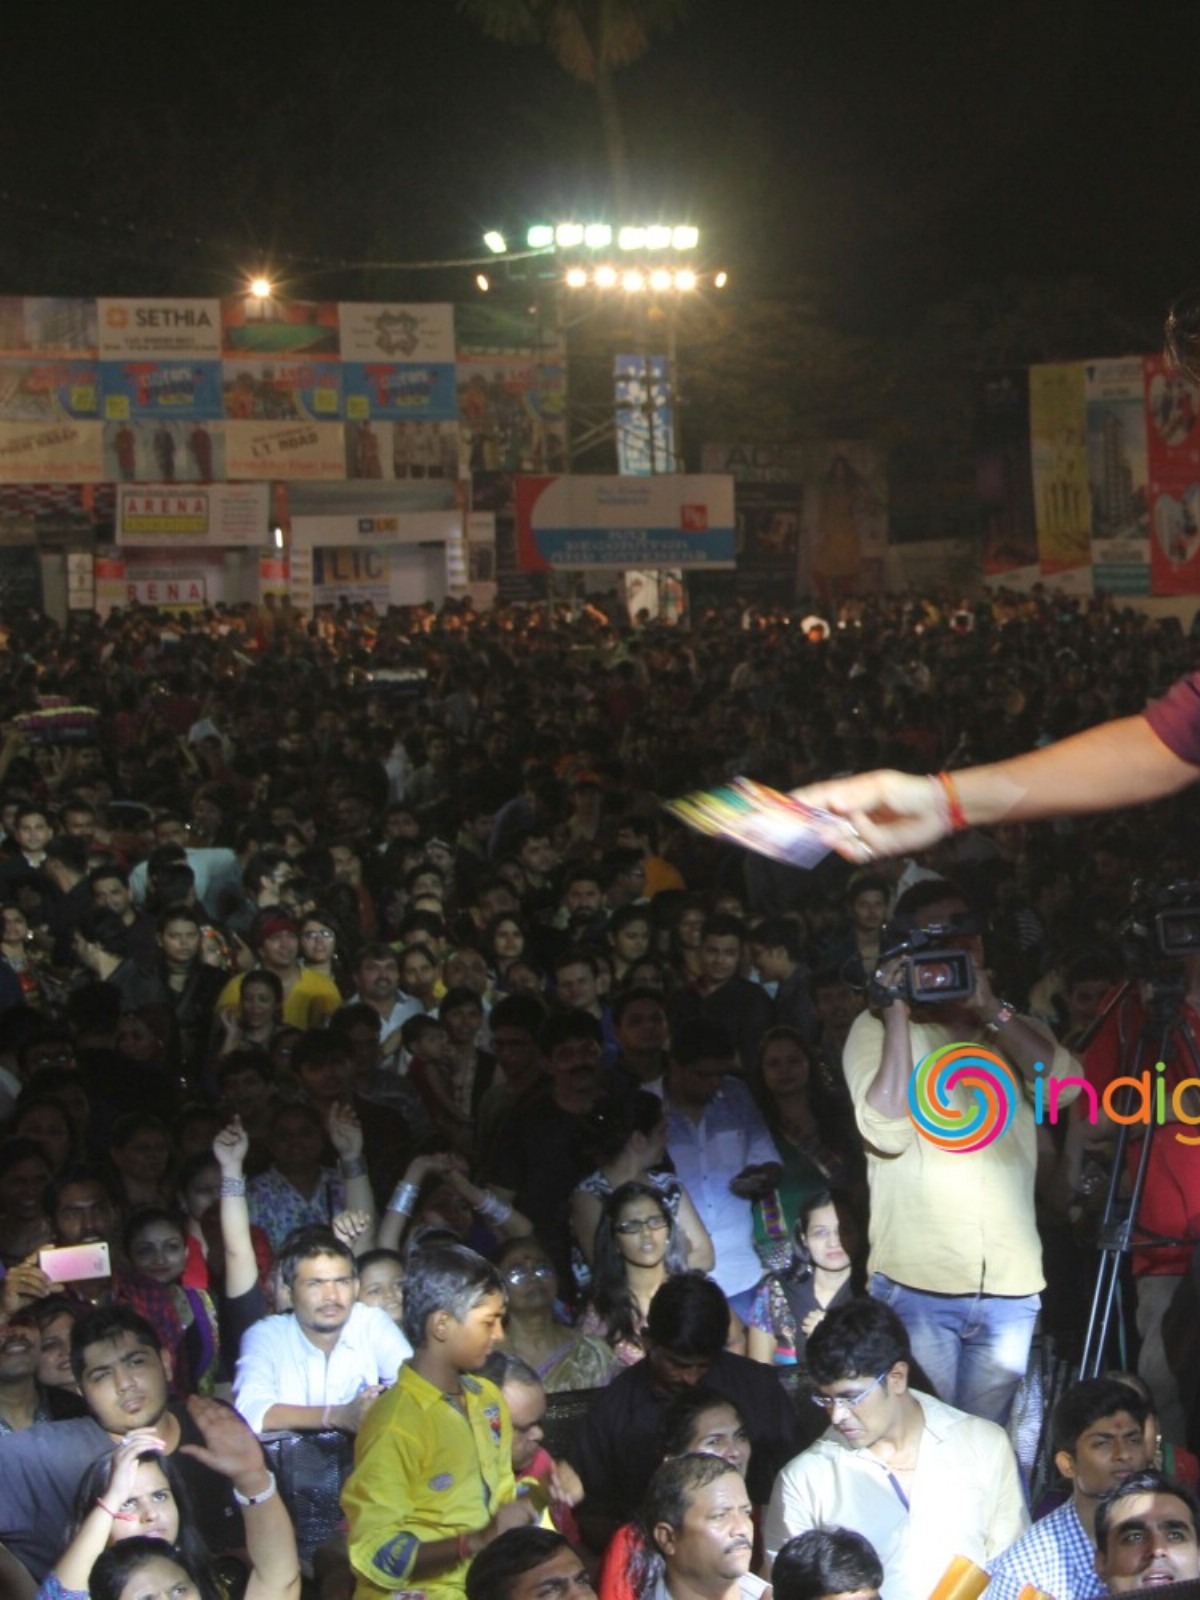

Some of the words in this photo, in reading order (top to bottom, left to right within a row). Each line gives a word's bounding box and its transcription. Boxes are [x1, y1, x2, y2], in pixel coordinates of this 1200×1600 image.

[135, 308, 212, 328] SETHIA
[127, 499, 204, 513] ARENA
[332, 550, 383, 580] LIC
[127, 583, 201, 601] RENA
